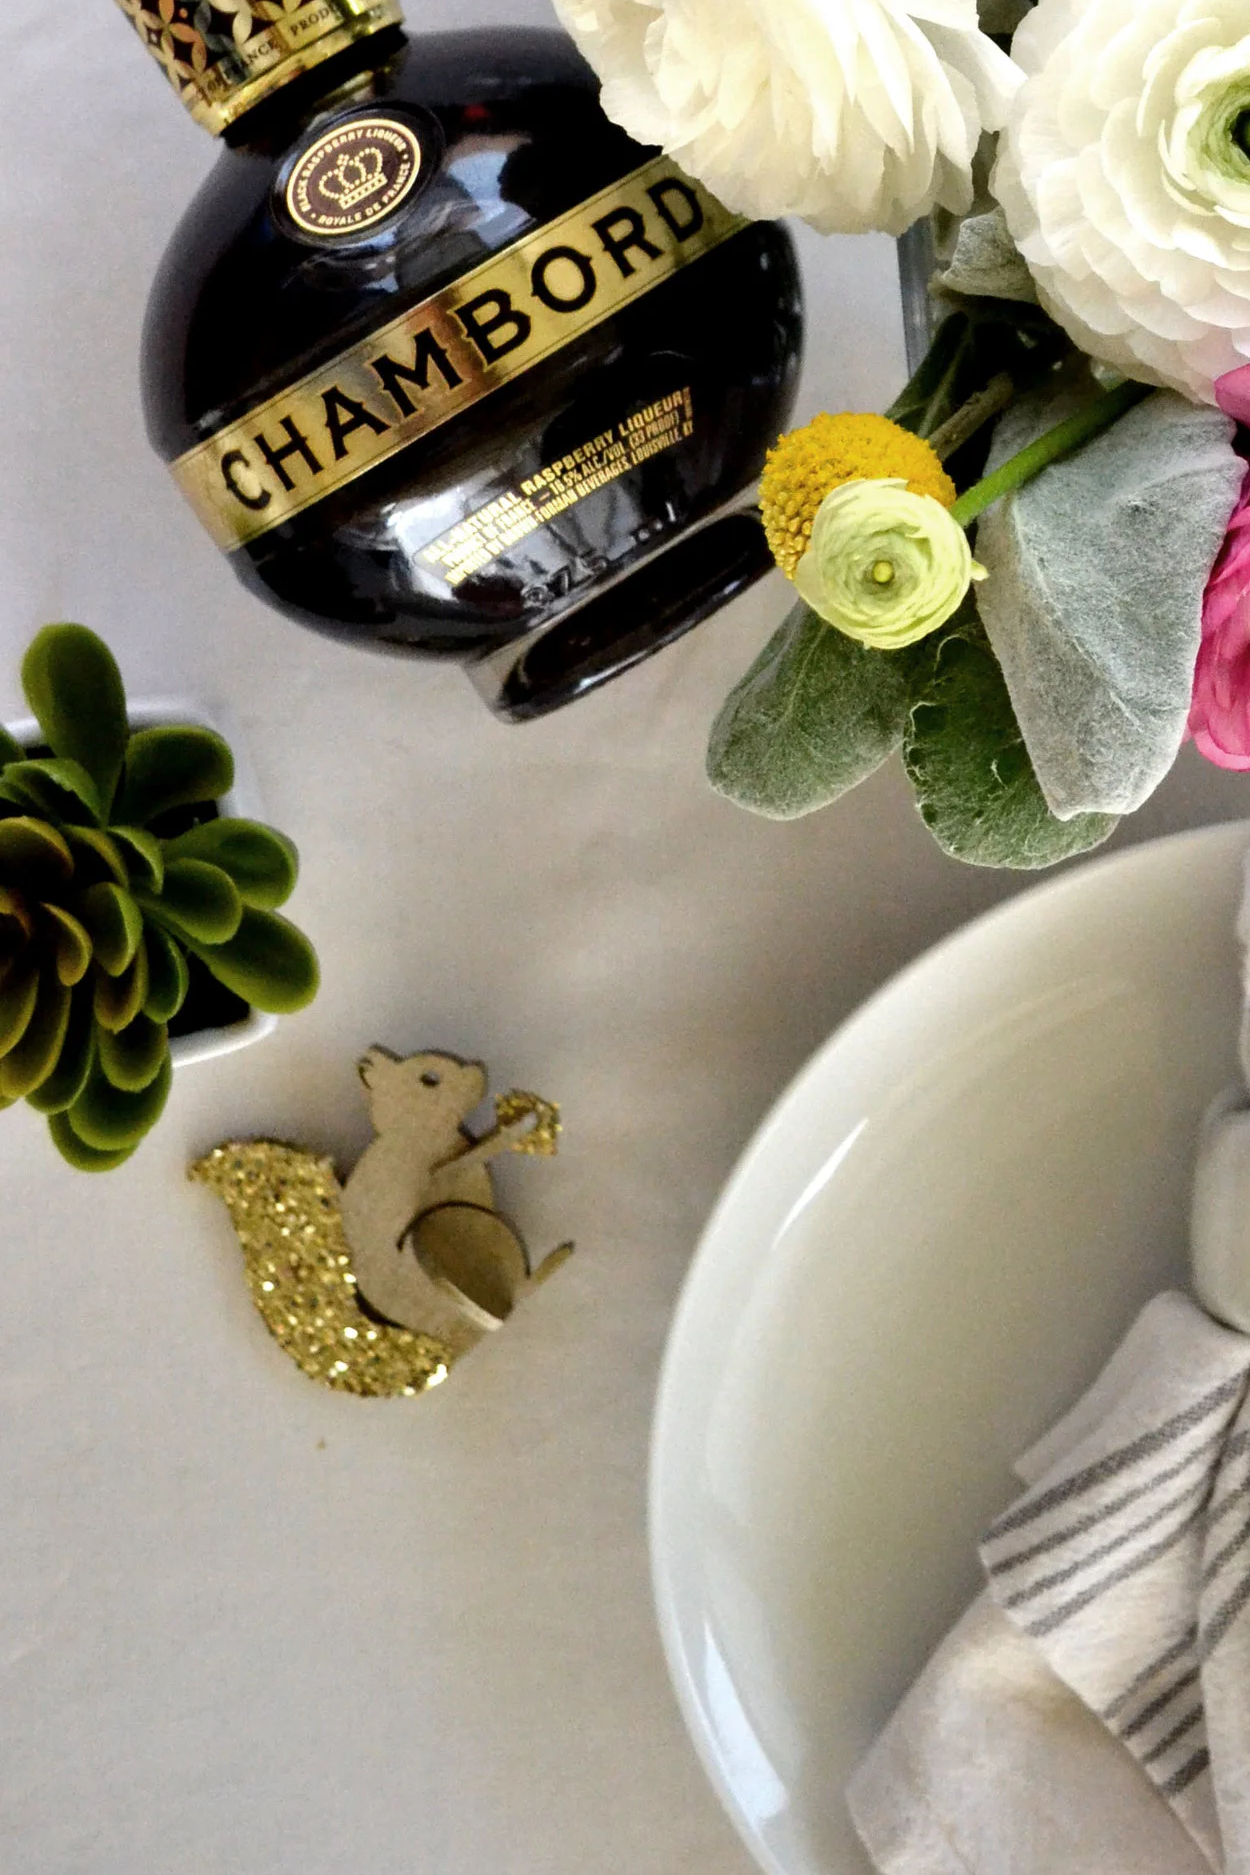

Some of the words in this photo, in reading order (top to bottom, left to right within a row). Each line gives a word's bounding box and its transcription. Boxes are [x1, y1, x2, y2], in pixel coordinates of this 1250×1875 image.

[301, 128, 364, 178] RASPBERRY
[365, 128, 407, 153] LIQUEUR
[317, 211, 362, 226] ROYALE
[364, 202, 382, 217] DE
[381, 161, 411, 204] FRANCE
[219, 175, 704, 512] CHAMBORD
[519, 428, 615, 496] RASPBERRY
[617, 389, 685, 438] LIQUEUR
[549, 467, 585, 496] 16.5%
[644, 410, 680, 439] PROOF)
